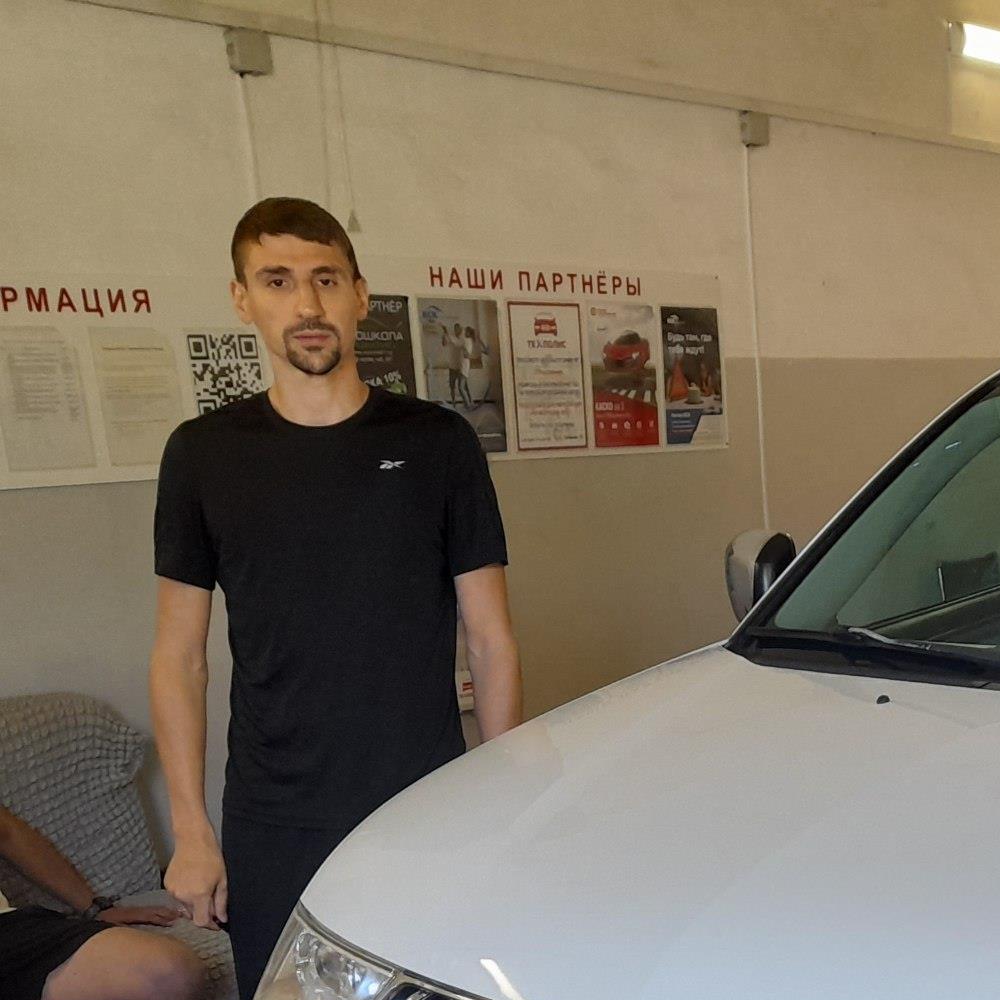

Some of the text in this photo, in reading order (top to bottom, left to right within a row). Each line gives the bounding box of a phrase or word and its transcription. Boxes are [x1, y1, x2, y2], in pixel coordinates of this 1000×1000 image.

[429, 266, 641, 296] НАШИ ПАРТНЁРЫ
[0, 286, 151, 318] РМАЦИЯ
[368, 300, 403, 314] РТНЁР
